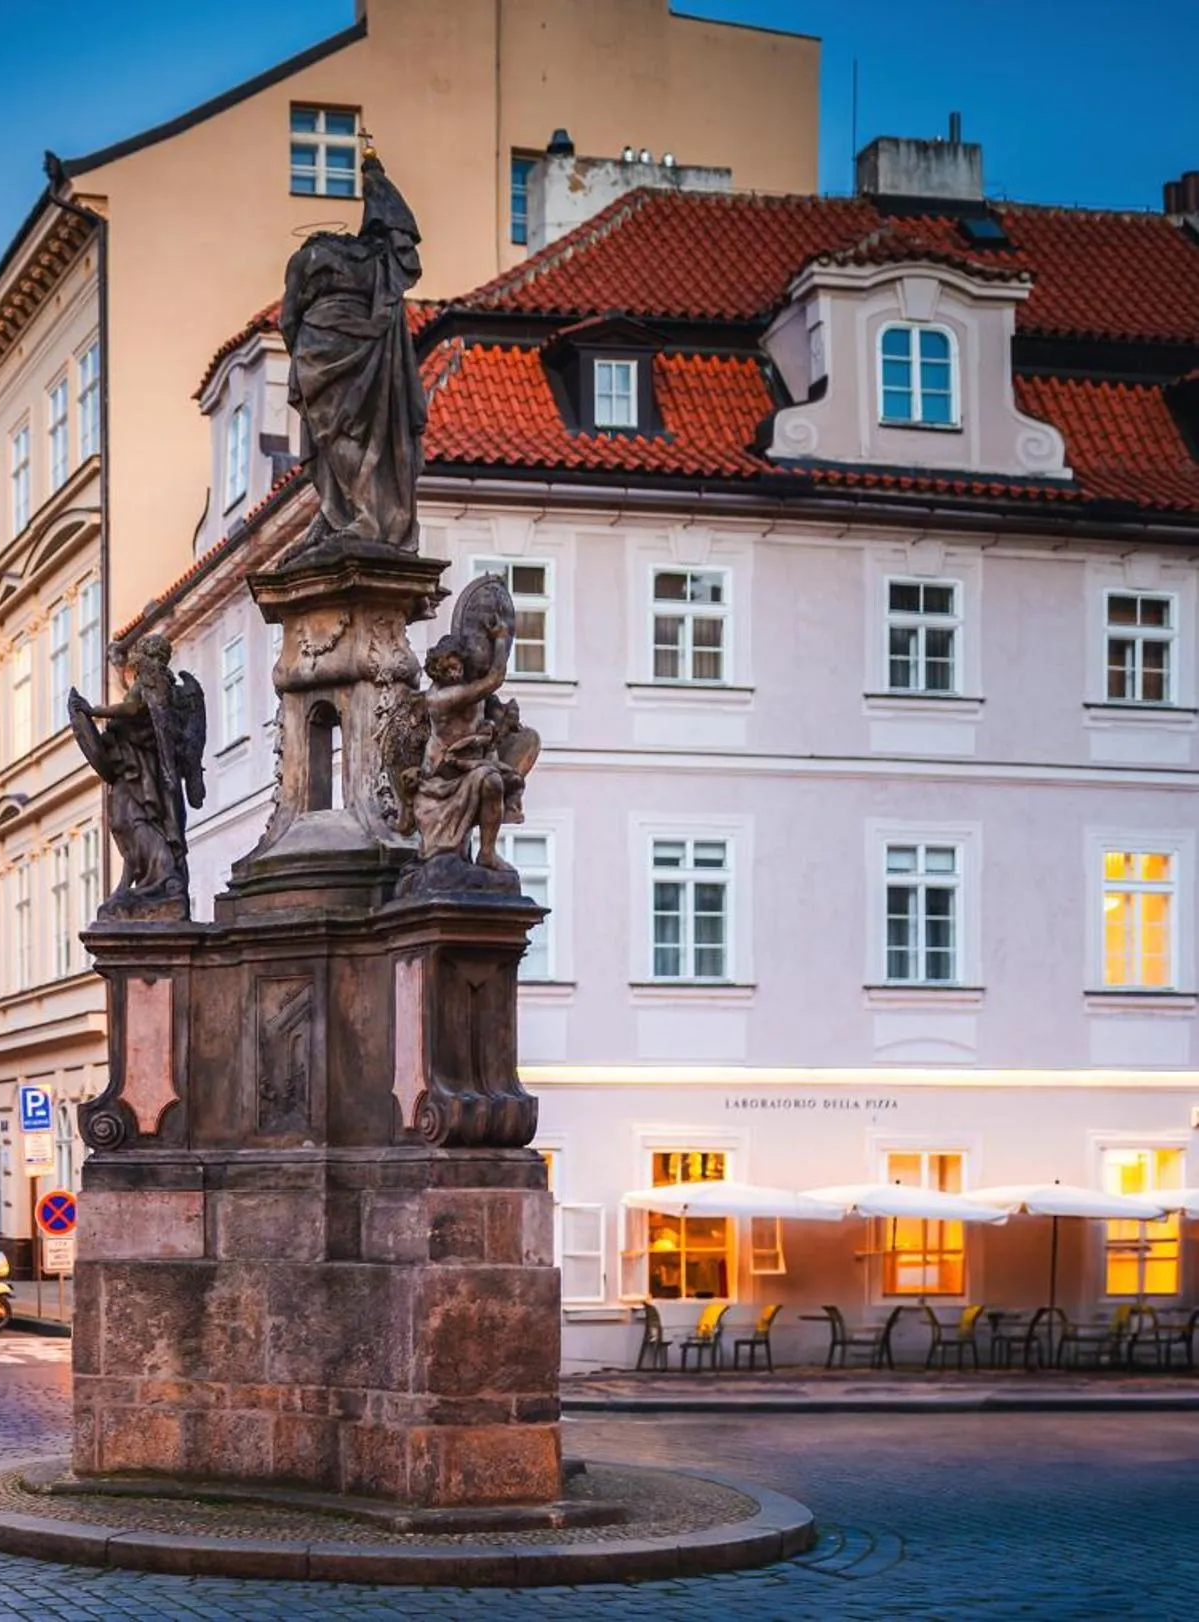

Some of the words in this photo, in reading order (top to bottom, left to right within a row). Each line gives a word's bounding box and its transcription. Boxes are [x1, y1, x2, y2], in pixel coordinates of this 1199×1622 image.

[26, 1090, 45, 1117] P
[724, 1097, 817, 1110] LABORATORIO
[823, 1098, 860, 1110] DELLA
[865, 1098, 898, 1110] PIZZA
